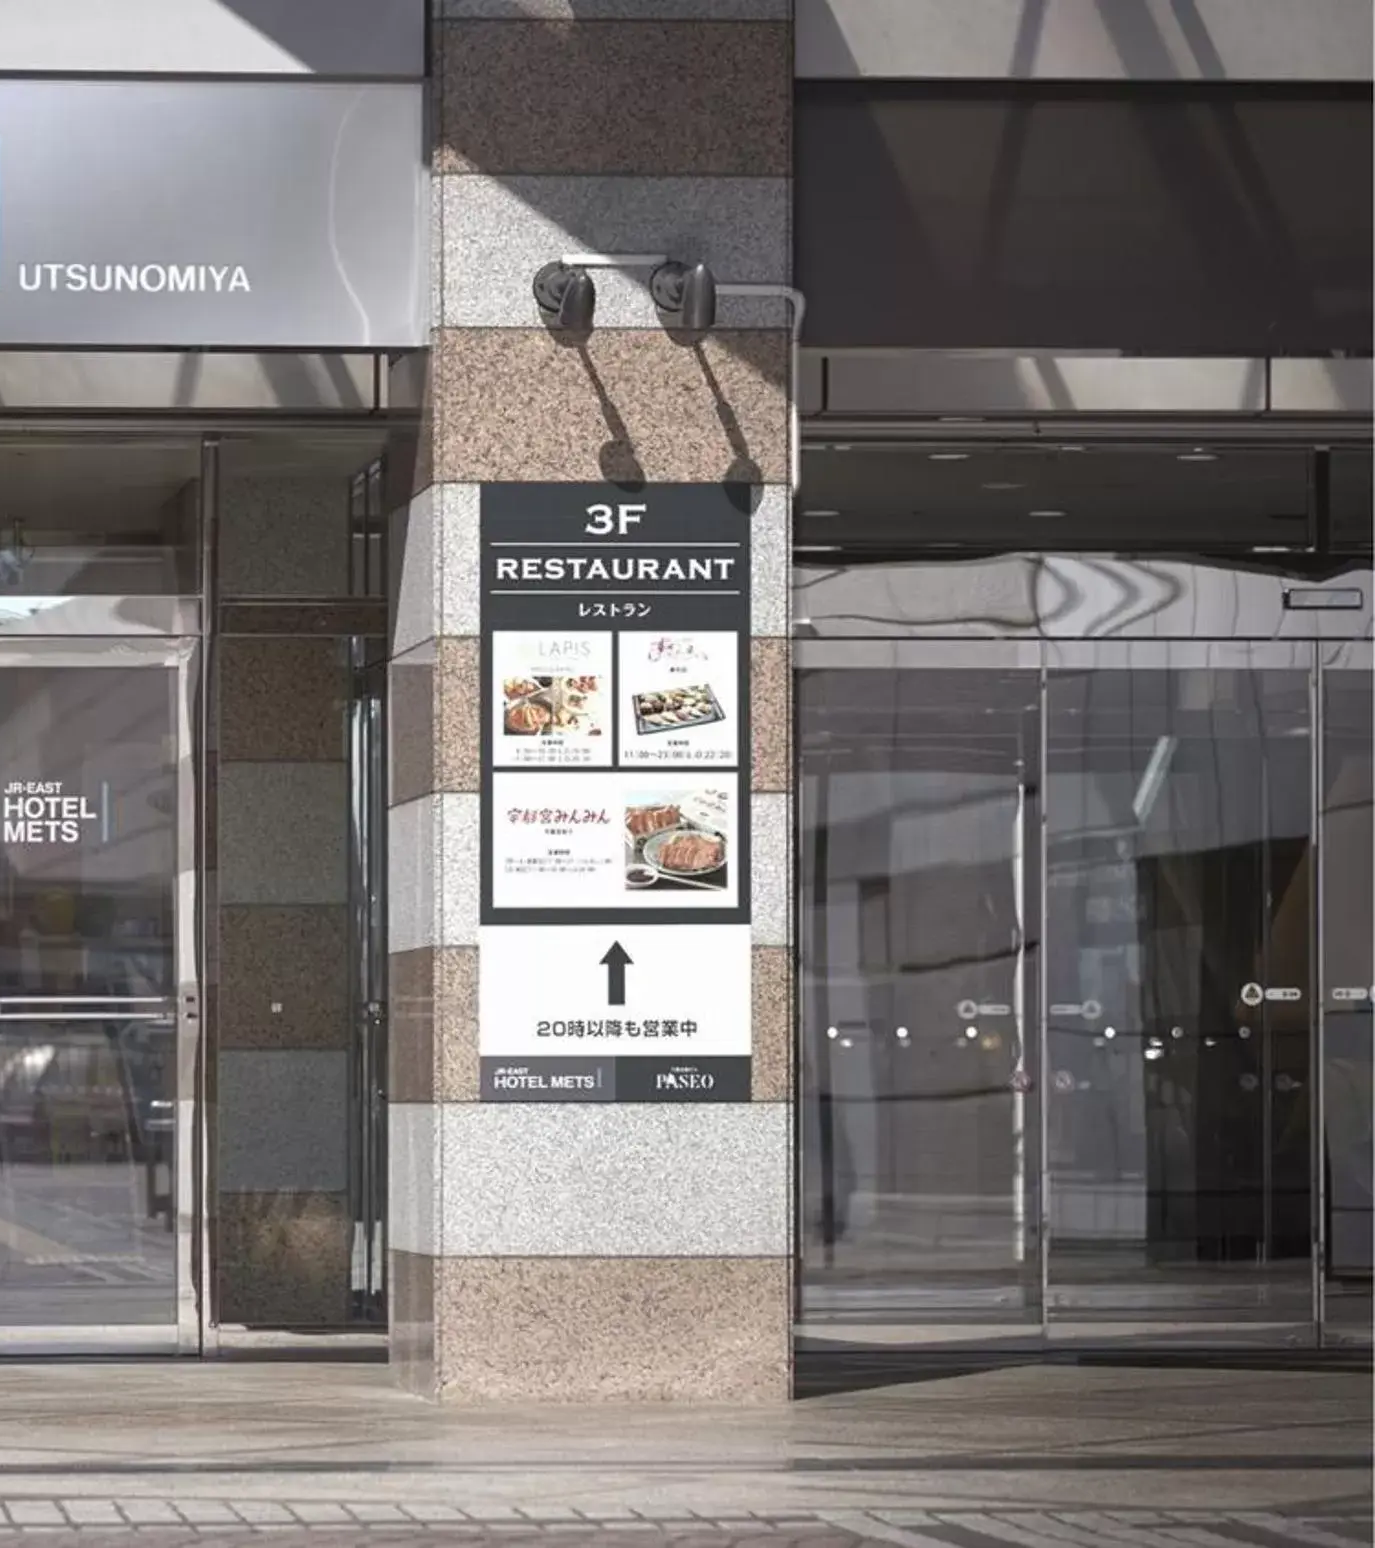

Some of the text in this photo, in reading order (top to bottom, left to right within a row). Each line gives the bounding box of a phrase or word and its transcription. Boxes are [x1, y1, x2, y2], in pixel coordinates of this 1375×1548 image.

[18, 262, 252, 293] UTSUNOMIYA
[584, 503, 647, 535] 3F
[495, 557, 736, 581] RESTAURANT
[577, 602, 652, 618] レストラン
[538, 640, 592, 658] LAPIS
[3, 781, 63, 794] JR-EAST
[3, 796, 98, 819] HOTEL
[3, 820, 80, 843] METS
[536, 1019, 699, 1038] 20時以降も営業中
[493, 1075, 596, 1090] HOTEL METS
[655, 1073, 715, 1090] PASEO
